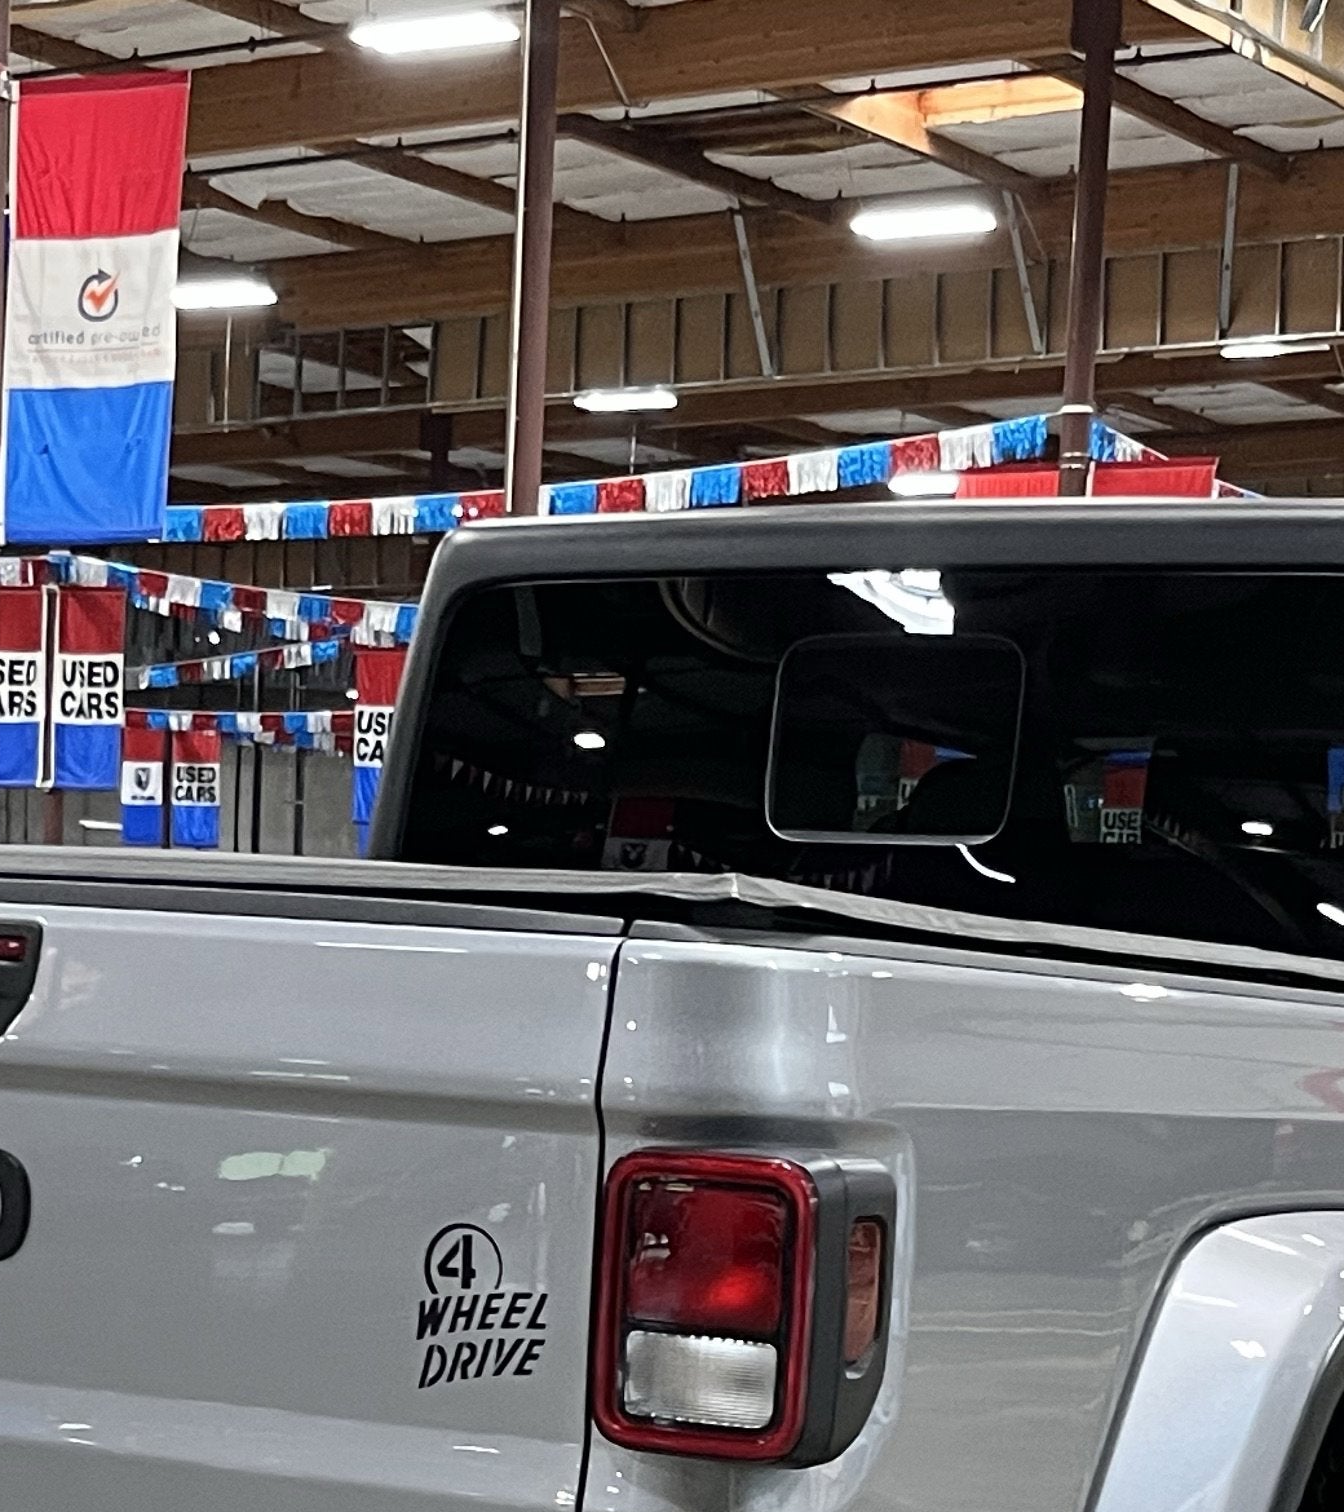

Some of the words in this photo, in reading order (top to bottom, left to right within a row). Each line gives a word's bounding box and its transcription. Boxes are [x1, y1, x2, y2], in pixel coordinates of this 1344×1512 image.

[62, 659, 119, 688] USED
[61, 691, 119, 719] CARS
[357, 710, 393, 736] US
[356, 737, 384, 764] CA
[176, 766, 216, 783] USED
[175, 785, 216, 802] CARS
[1104, 811, 1139, 830] USE
[437, 1234, 476, 1289] 4
[416, 1292, 549, 1340] WHEEL
[418, 1338, 546, 1389] DRIVE
